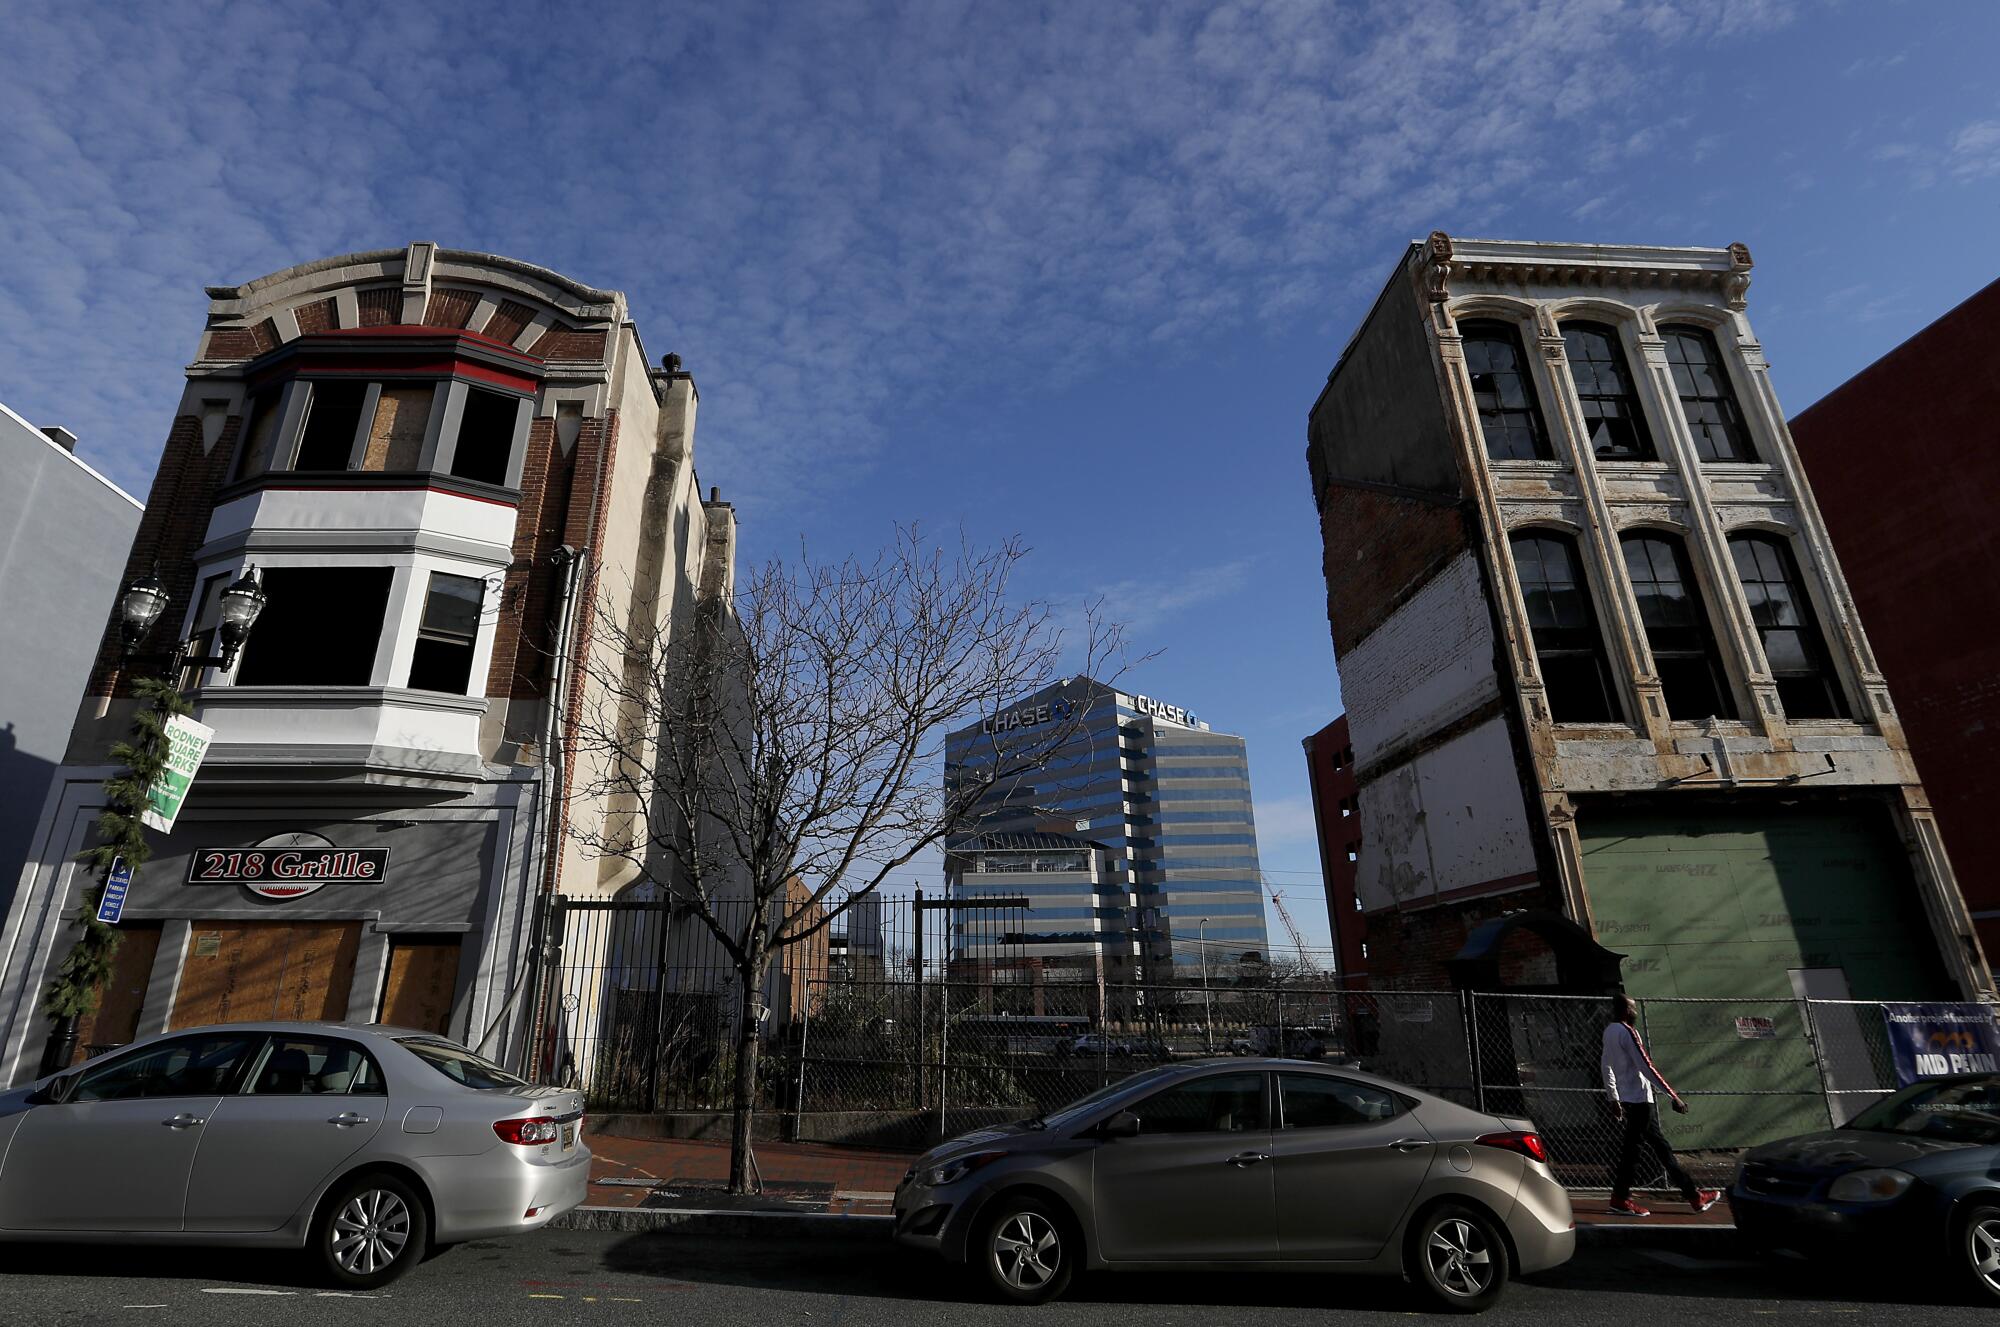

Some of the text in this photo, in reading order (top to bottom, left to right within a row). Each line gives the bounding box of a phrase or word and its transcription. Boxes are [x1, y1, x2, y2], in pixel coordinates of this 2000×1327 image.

[982, 703, 1050, 735] CHASE
[1138, 695, 1184, 724] CHASE
[166, 724, 207, 750] RODNEY
[167, 753, 197, 773] ORKS
[168, 741, 201, 761] QUARE
[200, 853, 376, 879] 218 Grille
[1735, 1016, 1774, 1028] NATIONAL
[1915, 1053, 1998, 1075] MID PENN
